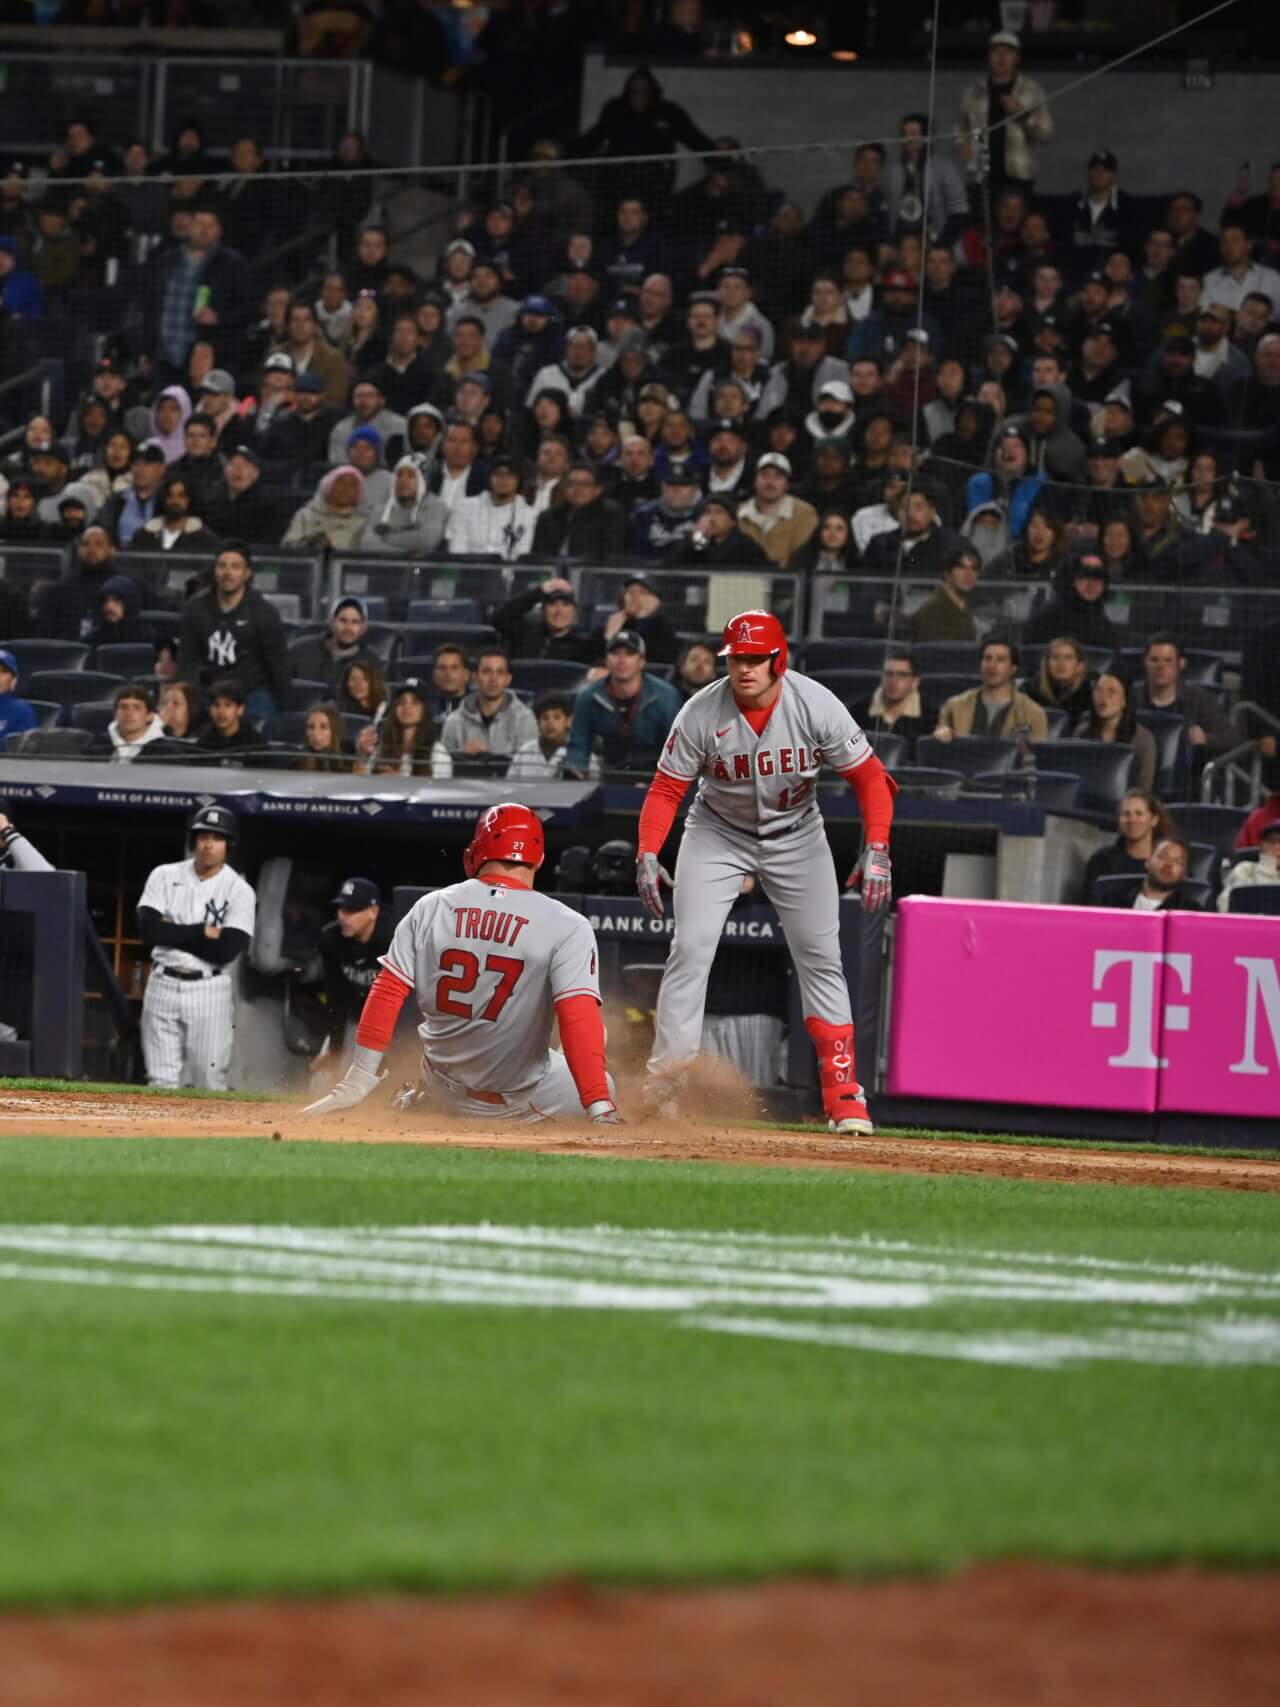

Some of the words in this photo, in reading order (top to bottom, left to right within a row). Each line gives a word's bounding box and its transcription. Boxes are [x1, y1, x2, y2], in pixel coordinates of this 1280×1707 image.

[208, 630, 237, 665] NY
[712, 747, 821, 782] ANGELS
[98, 792, 127, 803] BANK
[129, 794, 143, 804] OF
[145, 794, 193, 806] AMERICA
[262, 801, 291, 812] BANK
[293, 802, 309, 812] OF
[310, 803, 359, 815] AMERICA
[432, 808, 461, 819] BANK
[513, 841, 525, 851] 27
[205, 898, 228, 926] NY
[590, 915, 644, 932] BANK
[724, 921, 773, 937] RICA
[454, 907, 529, 947] TROUT
[435, 948, 525, 1022] 27
[1092, 949, 1192, 1068] T
